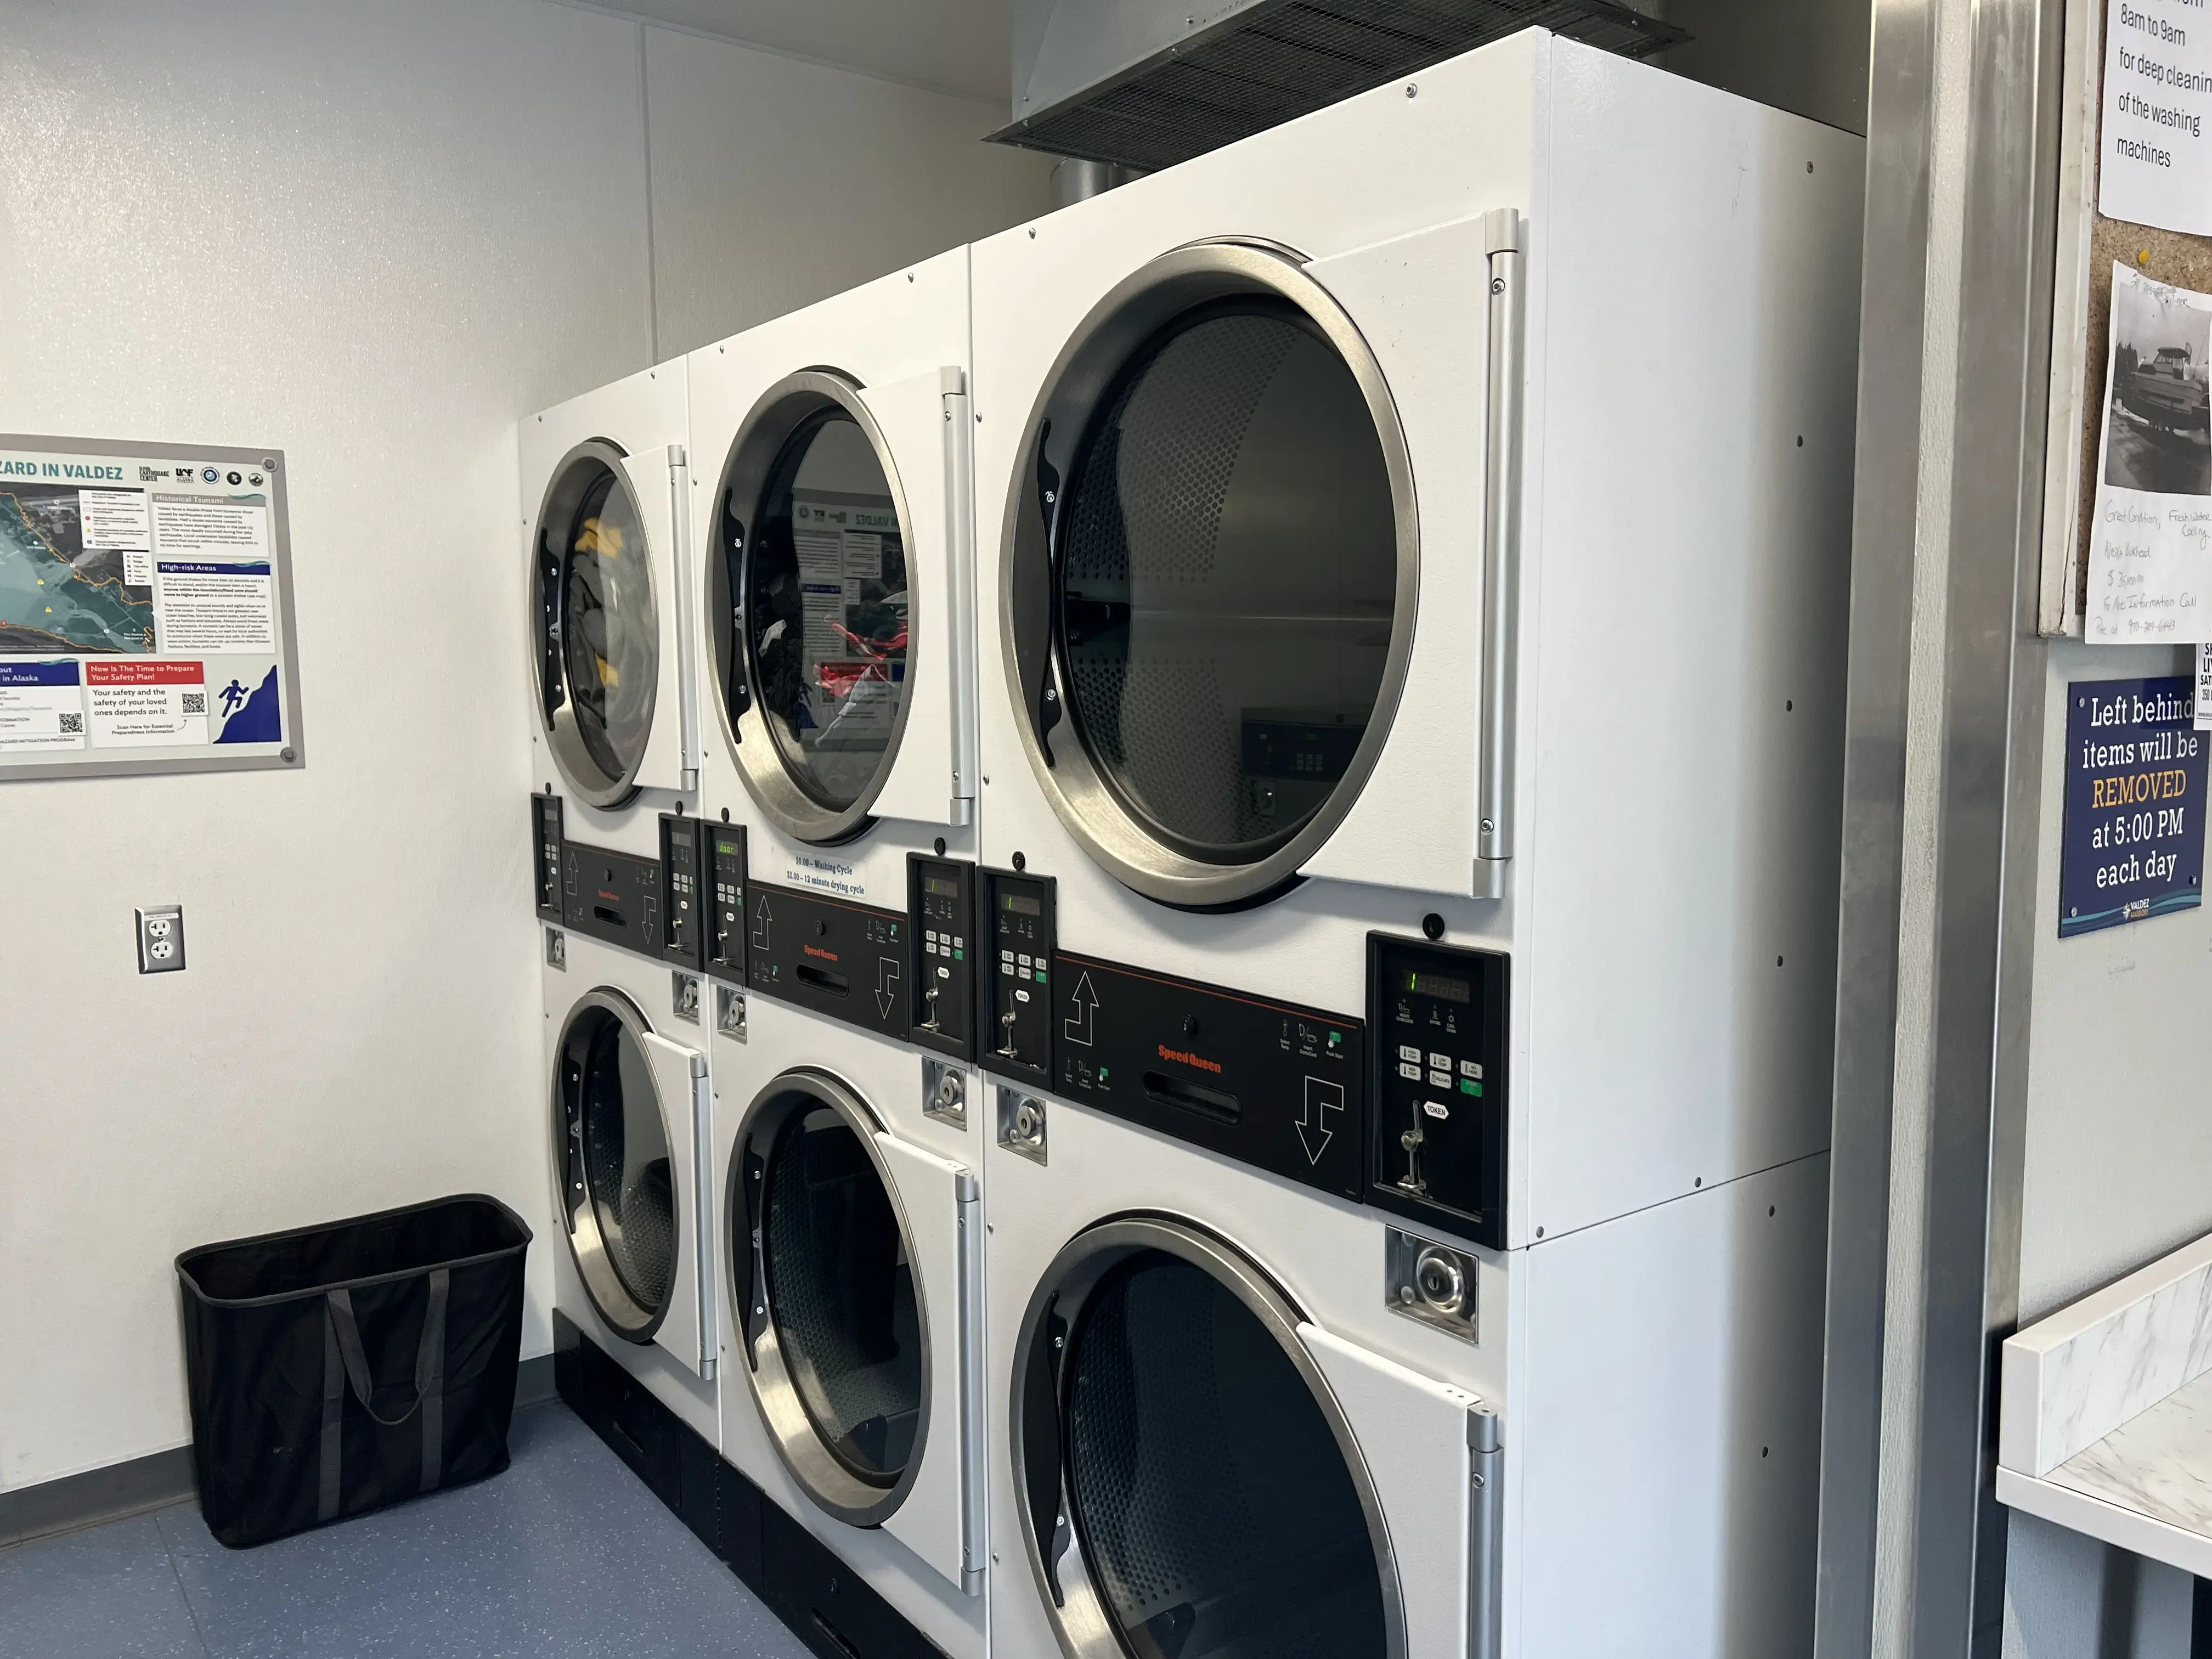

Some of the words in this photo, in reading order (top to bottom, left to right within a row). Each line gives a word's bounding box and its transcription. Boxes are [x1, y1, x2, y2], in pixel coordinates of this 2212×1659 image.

[2120, 3, 2145, 31] 8am
[2148, 15, 2158, 36] to
[2160, 19, 2185, 46] 9am
[2120, 47, 2135, 70] for
[2137, 54, 2164, 85] deep
[2166, 66, 2212, 93] cleanin
[2119, 92, 2130, 112] of
[2132, 95, 2149, 119] the
[2151, 105, 2200, 137] washing
[2117, 138, 2171, 167] machines
[42, 463, 59, 477] IN
[63, 464, 123, 480] VALDEZ
[161, 563, 194, 572] High-risk
[2200, 674, 2212, 686] SAT
[112, 689, 135, 697] safety
[93, 698, 116, 707] safety
[2091, 695, 2128, 726] Left
[2132, 692, 2194, 723] behind
[114, 708, 146, 716] depends
[2083, 739, 2135, 769] items
[2140, 732, 2172, 762] will
[2176, 731, 2198, 758] be
[2092, 769, 2187, 809] REMOVED
[2092, 821, 2110, 849] at
[2115, 812, 2153, 845] 5:00
[2157, 807, 2185, 838] PM
[719, 842, 733, 853] door
[814, 860, 836, 874] Washing
[837, 864, 853, 875] Cycle
[2096, 854, 2140, 888] each
[2145, 850, 2177, 882] day
[787, 870, 799, 881] $2.00
[804, 874, 810, 883] 12
[811, 877, 830, 887] minute
[831, 880, 849, 894] drying
[850, 885, 864, 895] cycle
[2130, 898, 2149, 910] VALDEZ
[804, 944, 821, 956] Speed
[821, 949, 838, 962] Queen
[1017, 992, 1028, 1000] TOKEN
[1158, 1044, 1189, 1064] Speed
[1189, 1053, 1221, 1073] Queen
[1427, 1105, 1446, 1116] TOKEN
